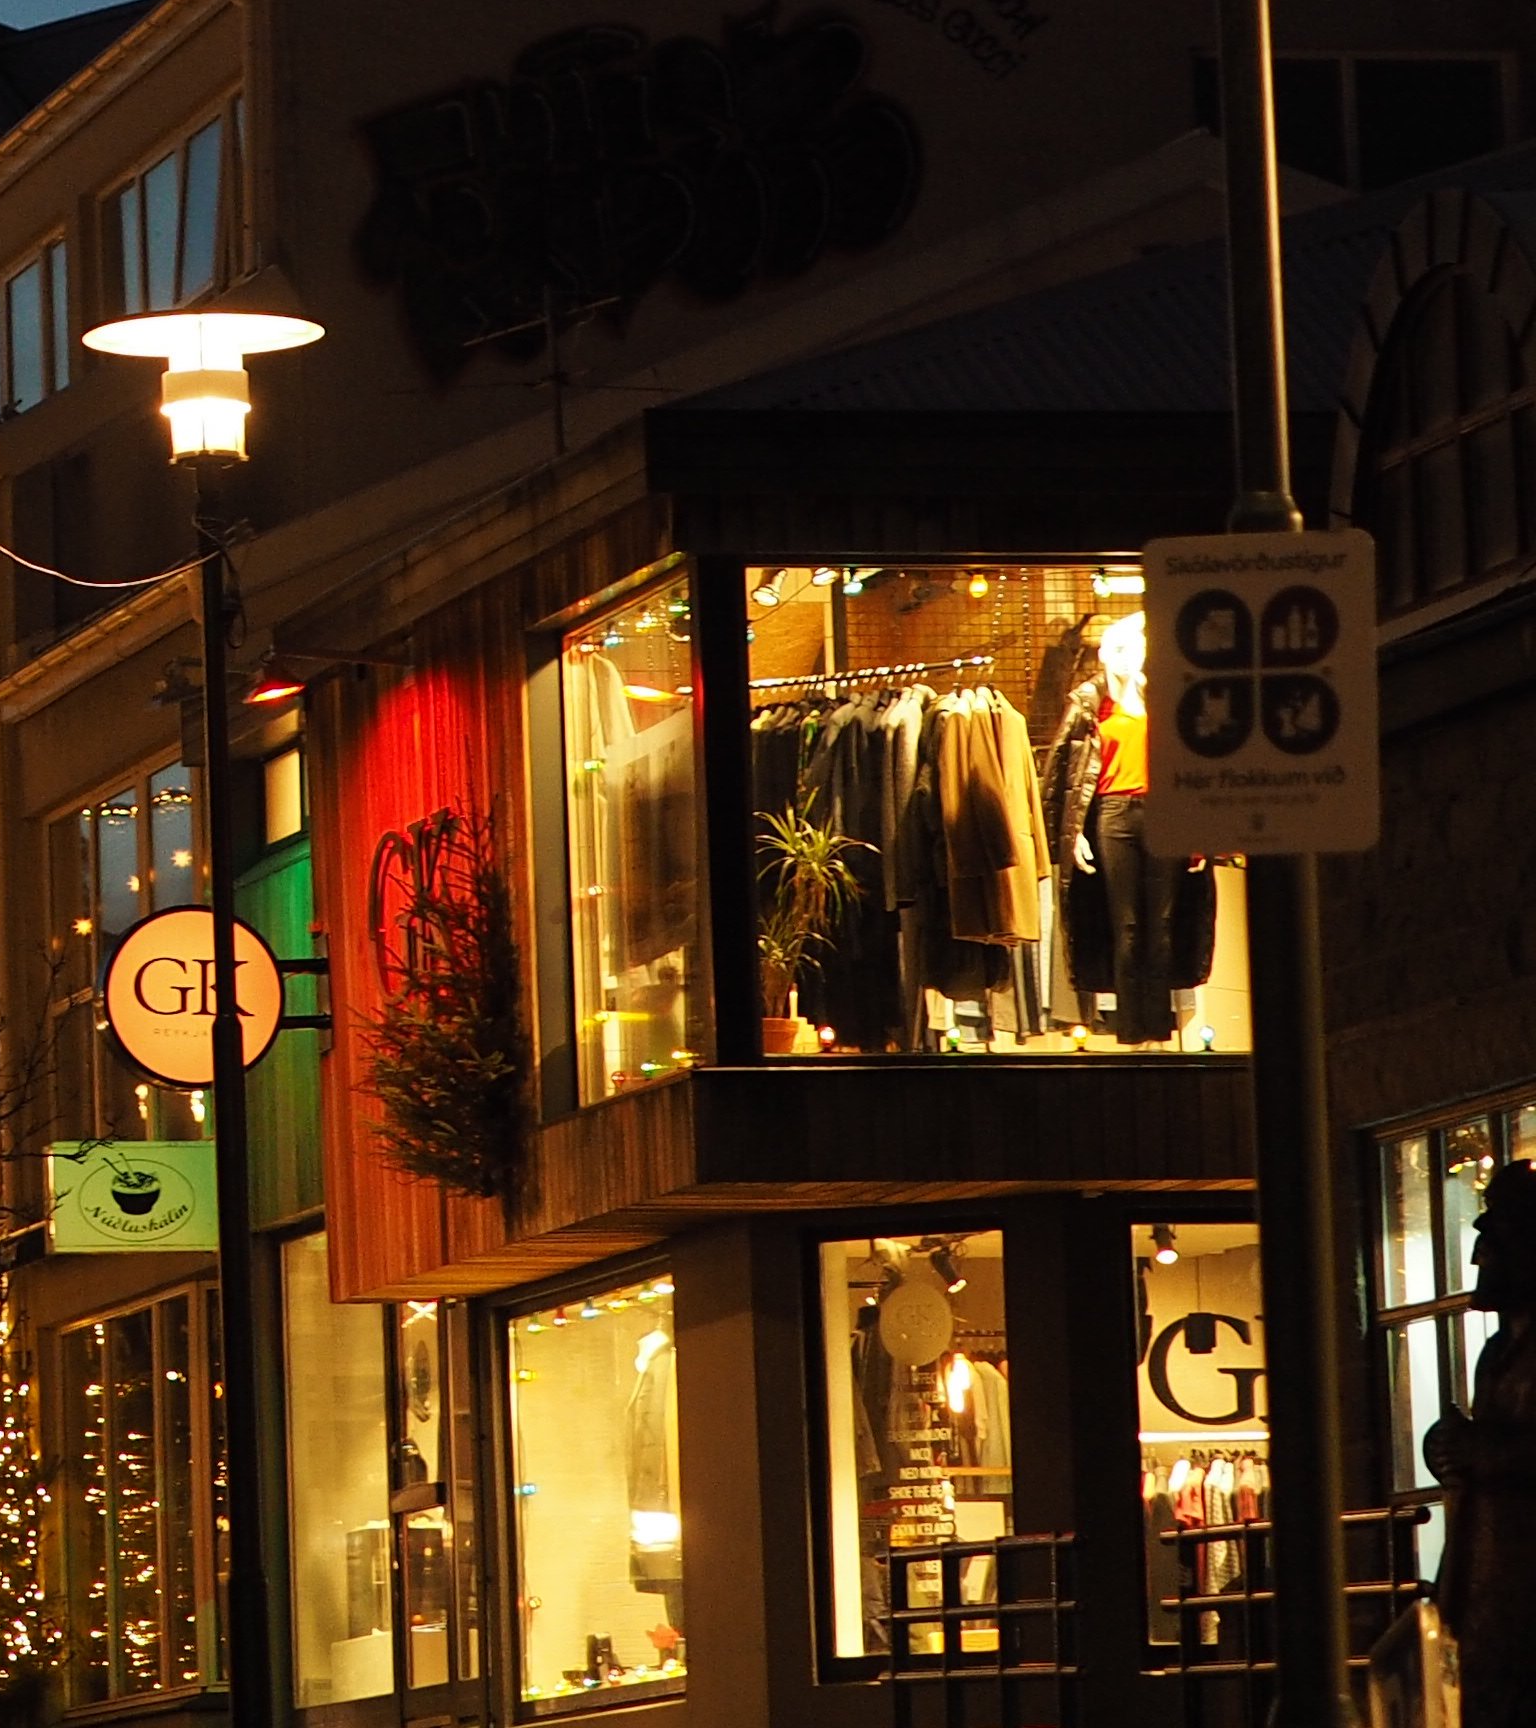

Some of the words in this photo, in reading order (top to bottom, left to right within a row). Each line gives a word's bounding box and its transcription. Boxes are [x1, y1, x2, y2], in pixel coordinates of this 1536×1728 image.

[134, 956, 255, 1017] GK
[153, 1027, 209, 1039] REYKJA
[1147, 1312, 1268, 1426] G
